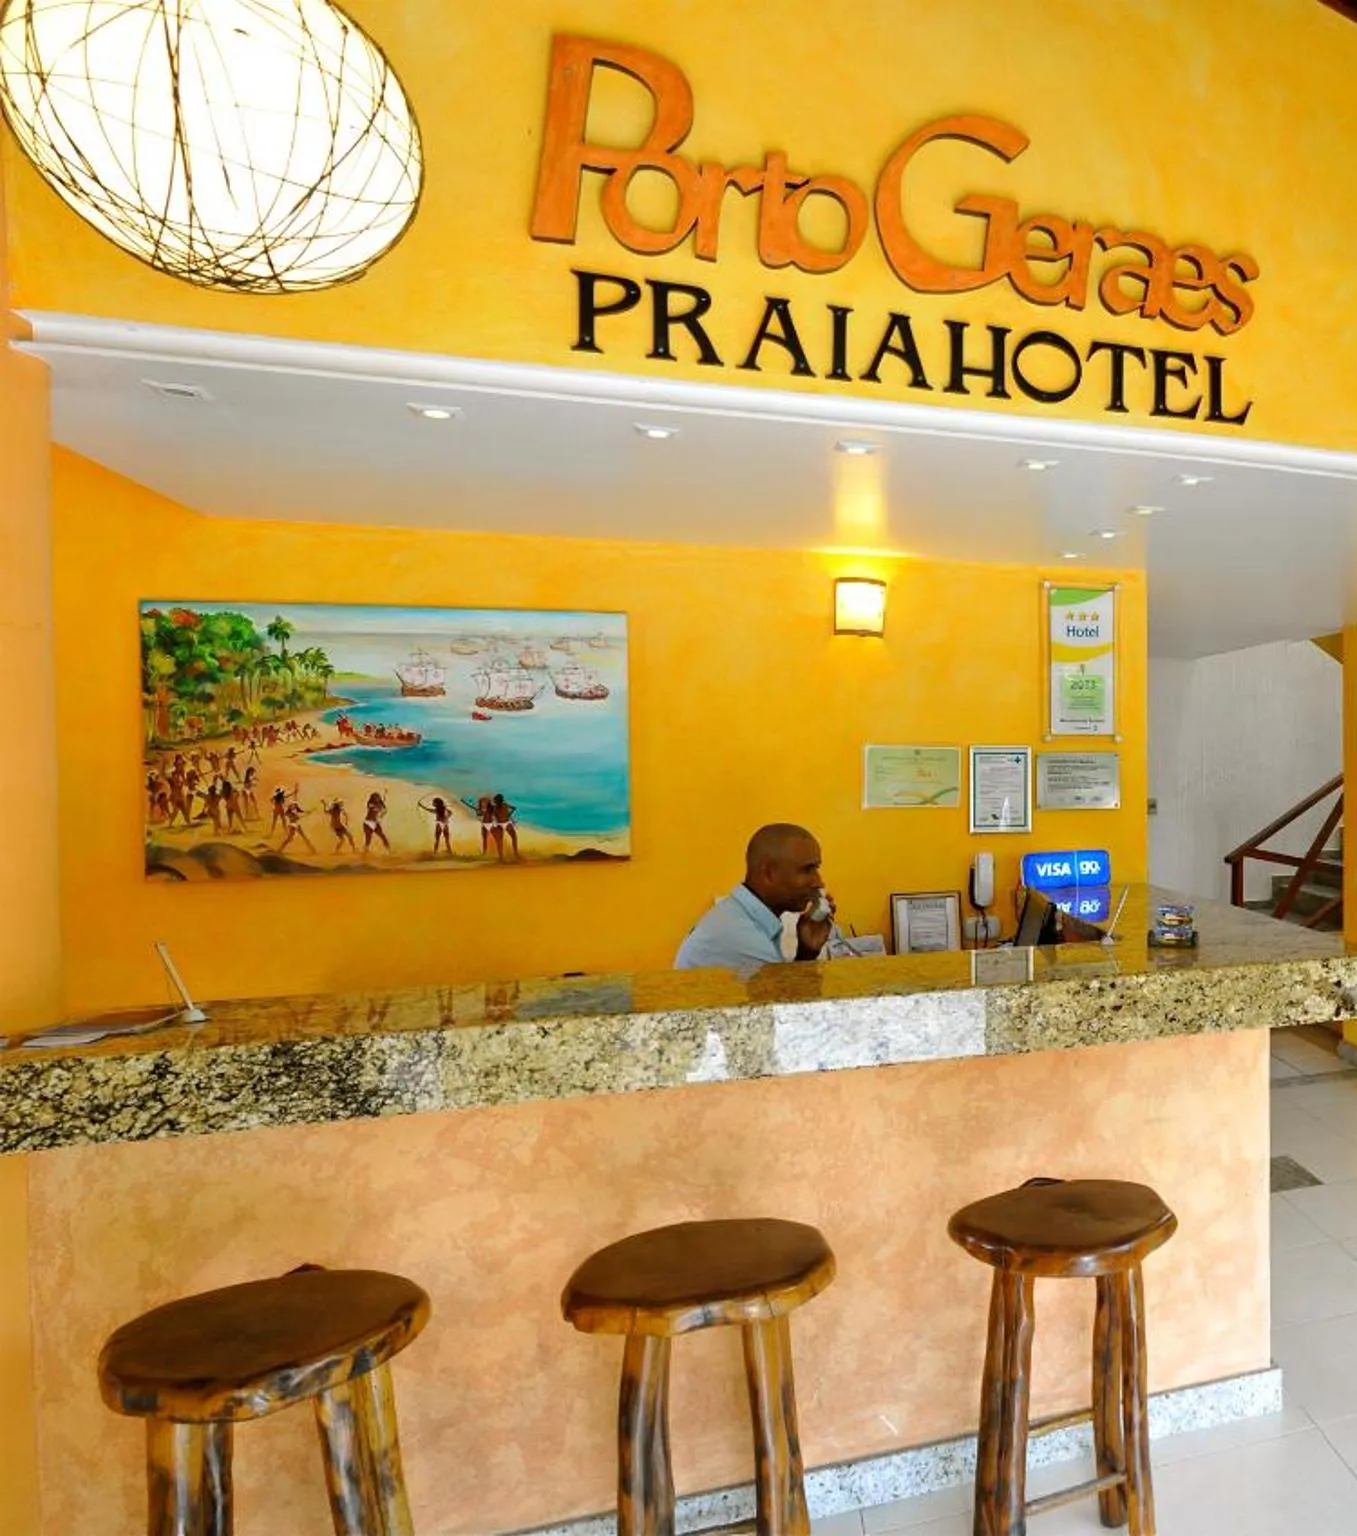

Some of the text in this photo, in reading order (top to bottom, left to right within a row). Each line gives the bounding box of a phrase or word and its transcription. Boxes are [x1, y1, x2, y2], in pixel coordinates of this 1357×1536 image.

[530, 32, 1261, 337] Porto Geraes
[1066, 625, 1100, 638] Hotel
[1035, 862, 1072, 877] VISA
